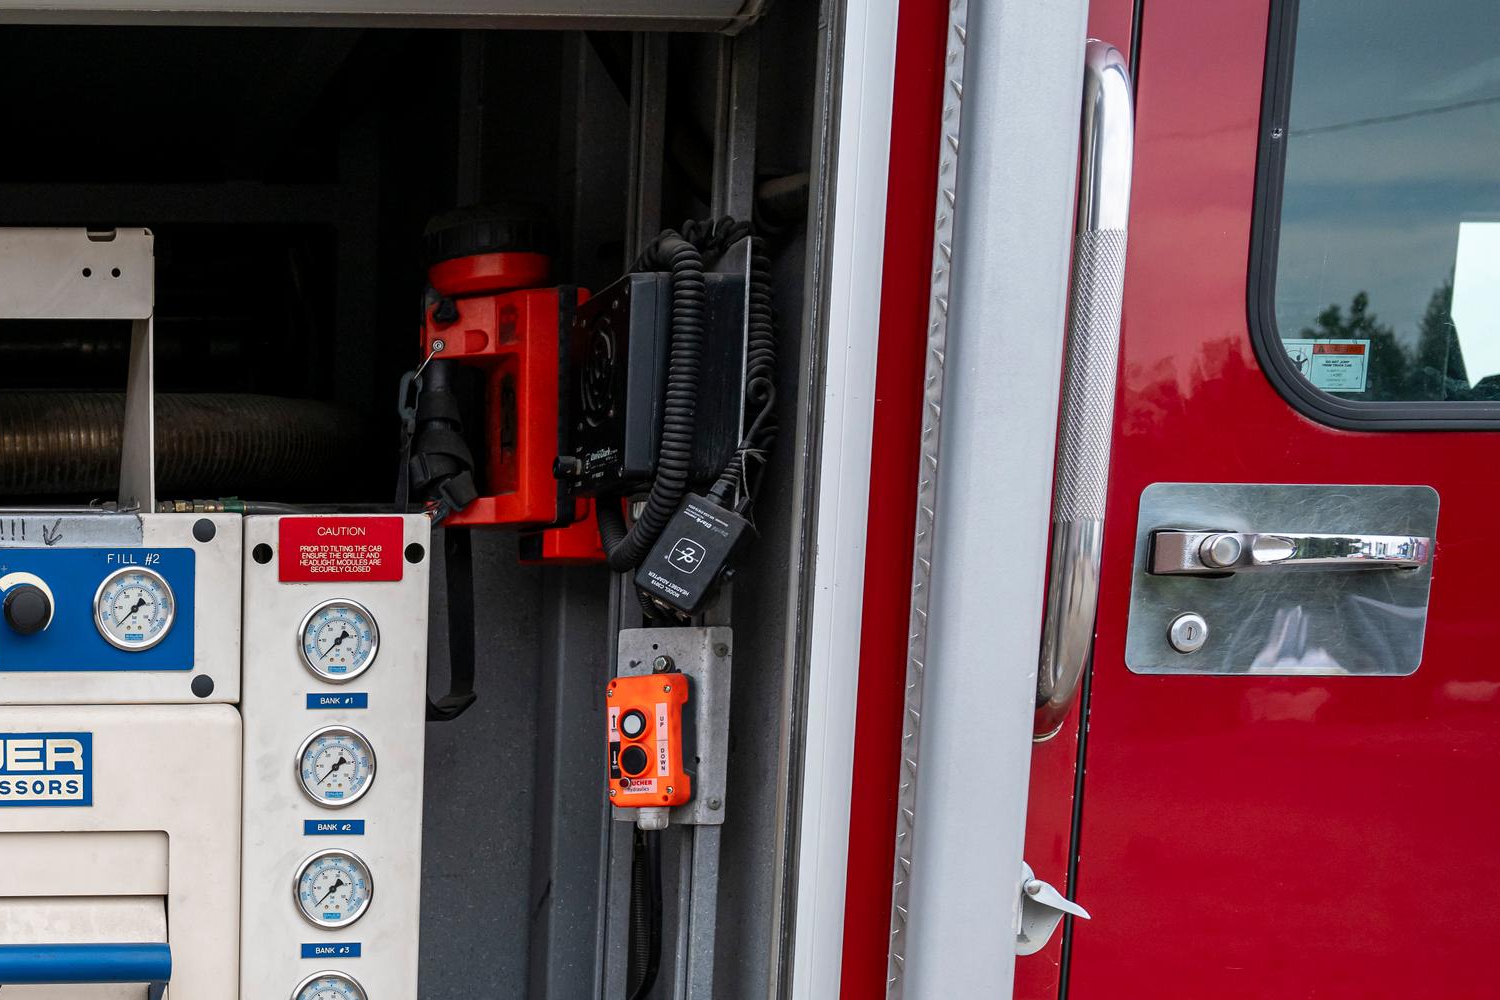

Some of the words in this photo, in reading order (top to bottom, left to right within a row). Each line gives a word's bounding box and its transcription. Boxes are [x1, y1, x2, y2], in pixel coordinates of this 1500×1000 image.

[317, 527, 366, 536] CAUTION
[107, 554, 137, 564] FILL
[144, 554, 160, 565] #2
[648, 570, 670, 585] ADAPTER
[668, 581, 691, 597] HEADSET
[345, 697, 353, 705] #1
[660, 716, 664, 727] UP
